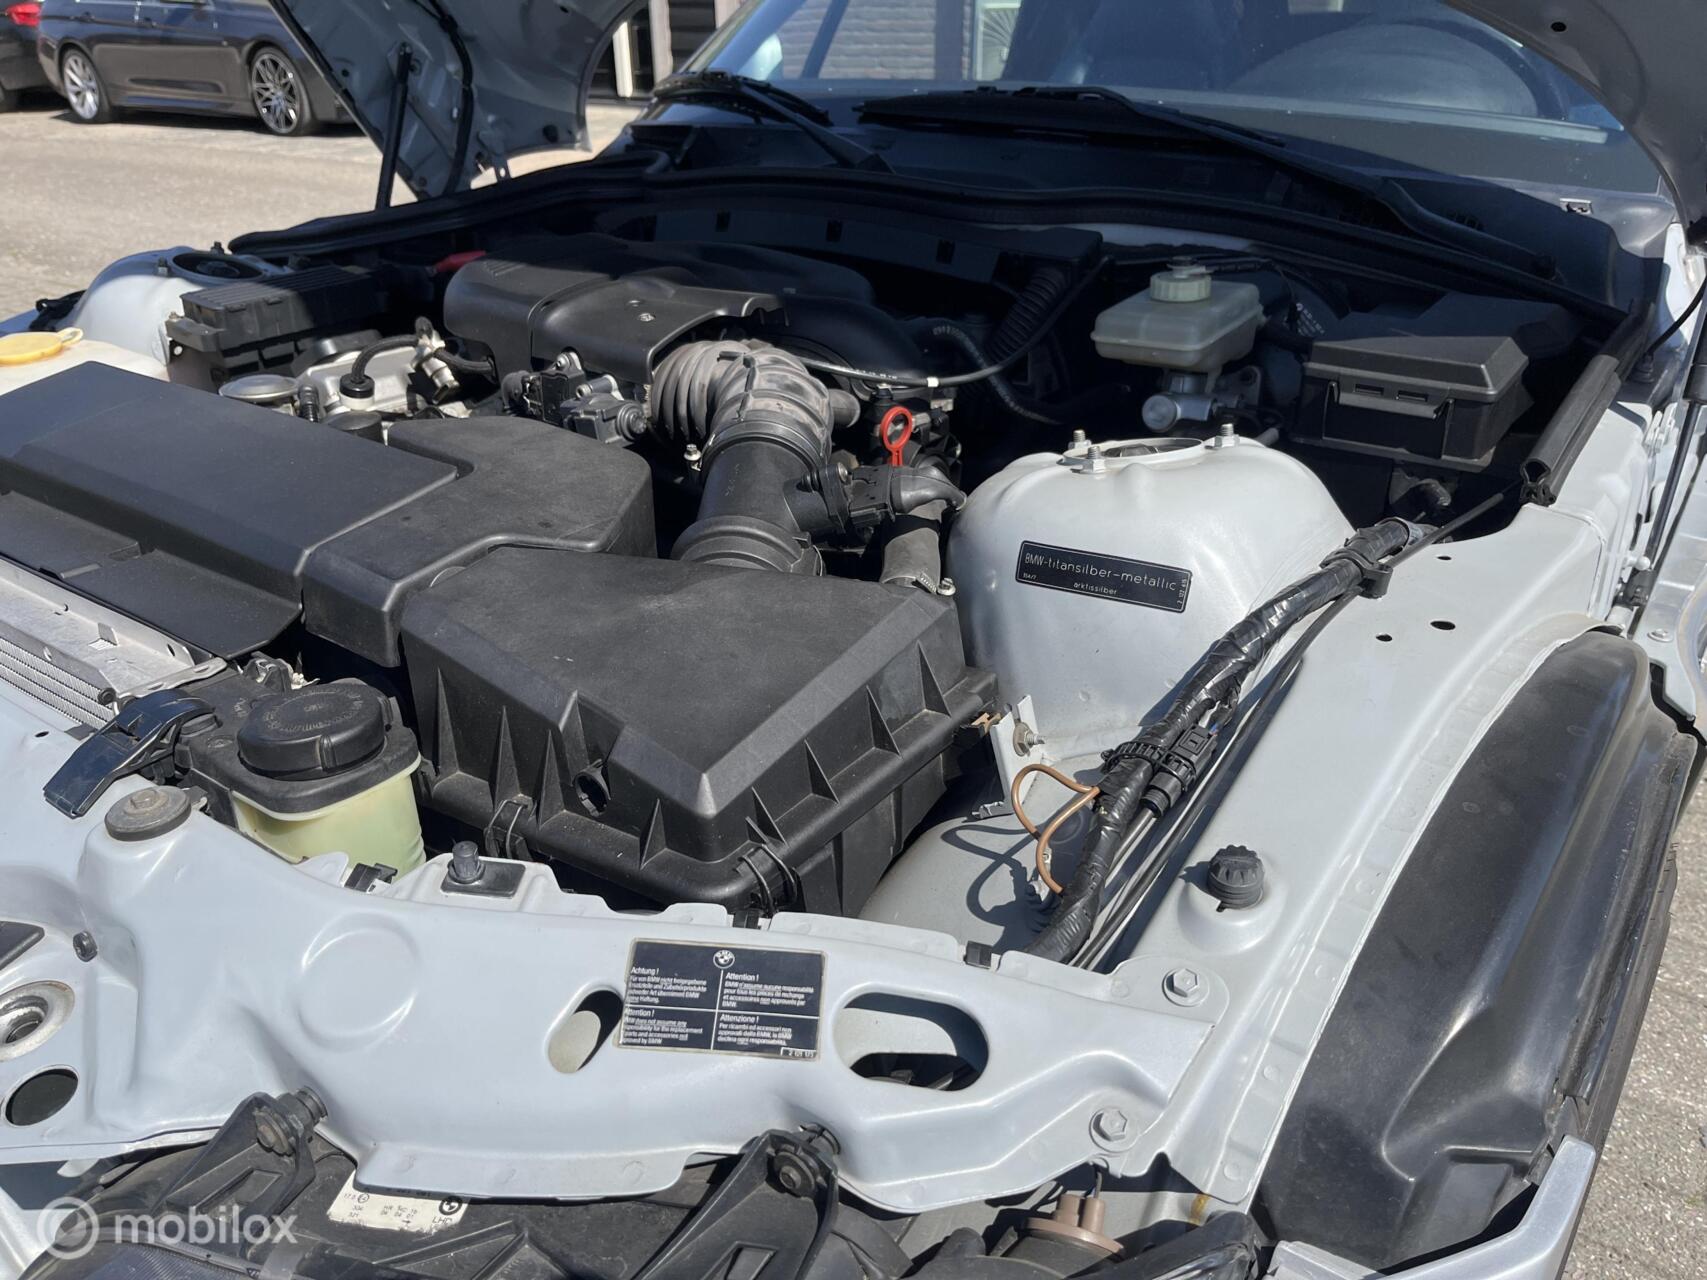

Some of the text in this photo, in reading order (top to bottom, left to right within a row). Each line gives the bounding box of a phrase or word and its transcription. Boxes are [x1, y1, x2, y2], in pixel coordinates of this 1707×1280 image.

[1073, 582, 1117, 595] arktissilber
[631, 967, 655, 975] Achtung
[725, 972, 756, 981] Attention
[719, 1013, 755, 1023] Attenzione
